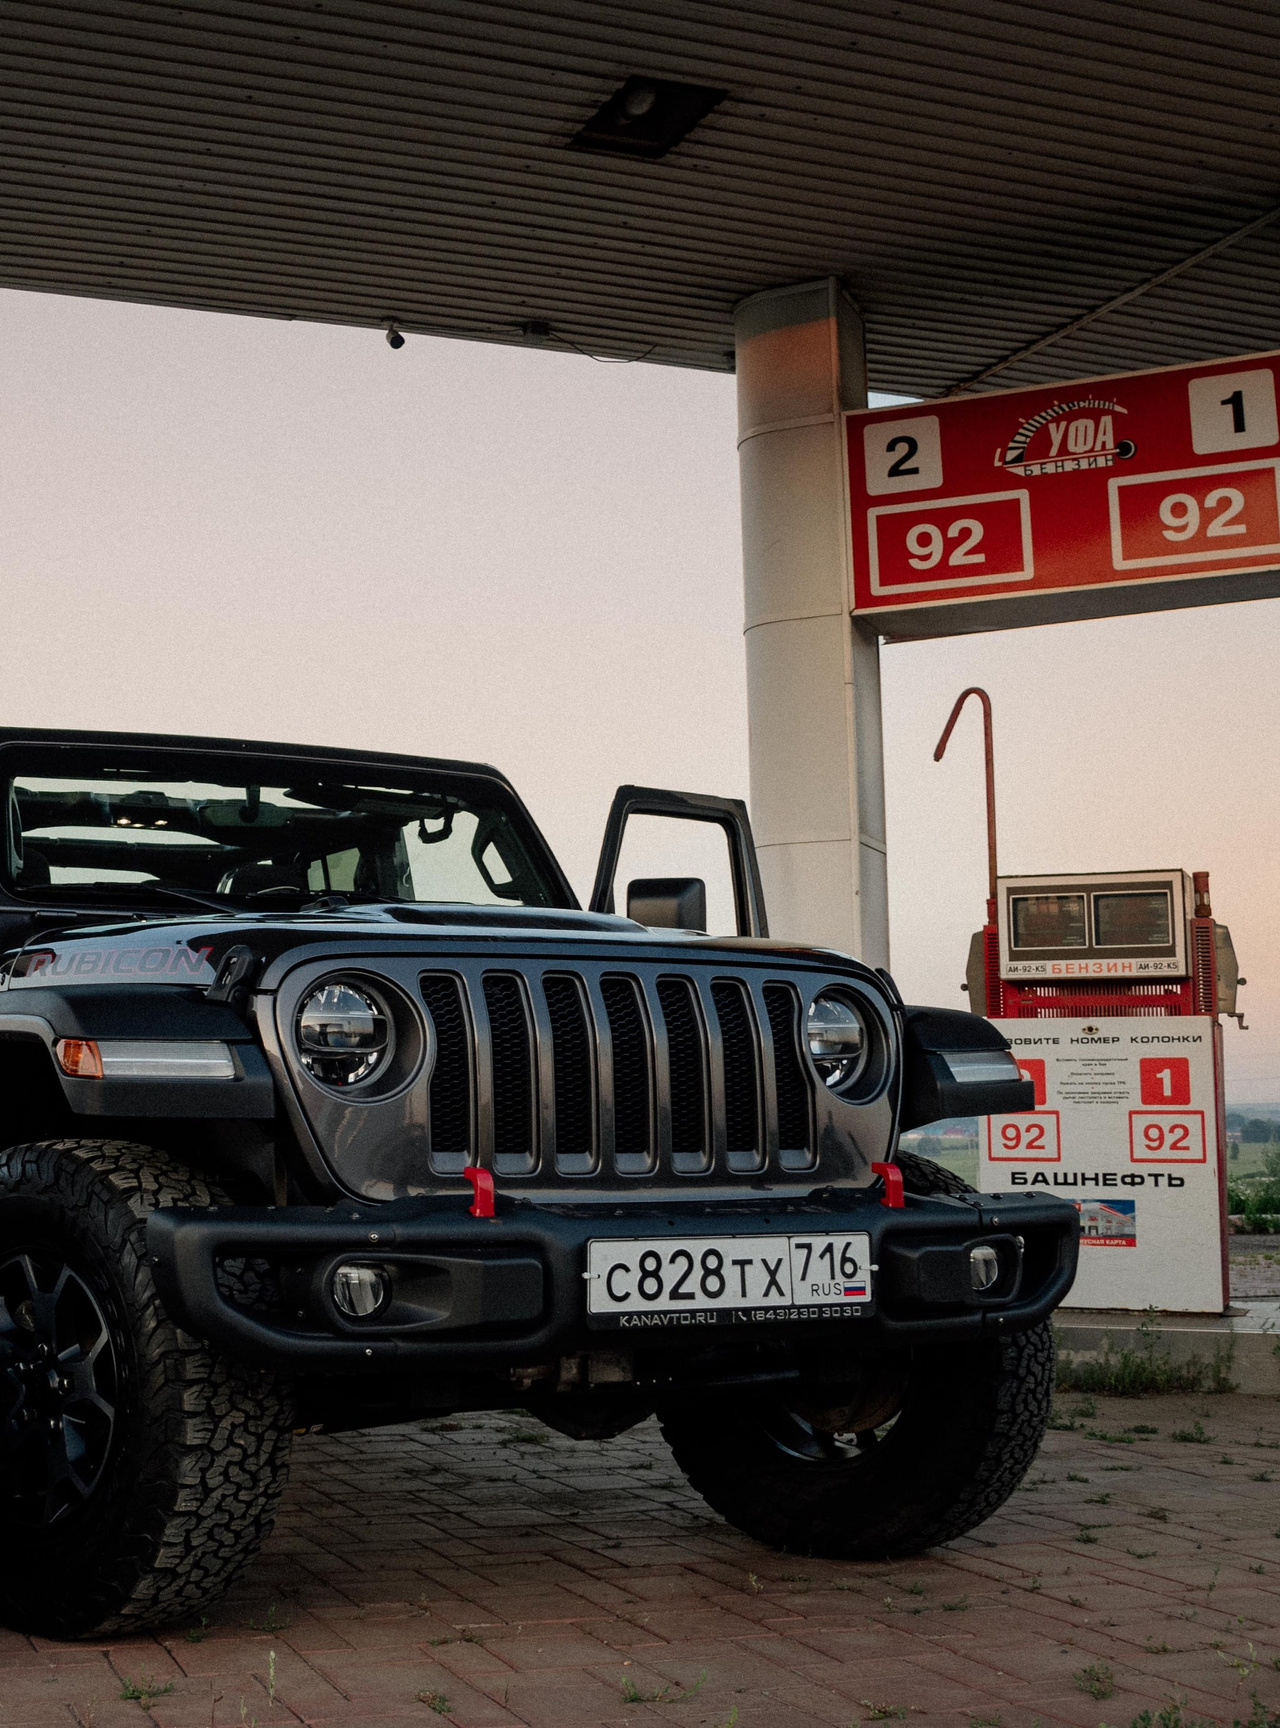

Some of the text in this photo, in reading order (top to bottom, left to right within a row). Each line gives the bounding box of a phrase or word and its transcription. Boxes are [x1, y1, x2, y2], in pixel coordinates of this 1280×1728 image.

[1220, 390, 1246, 434] 1
[1048, 415, 1114, 457] УФА
[885, 435, 919, 478] 2
[1023, 455, 1116, 476] БЕНЗИН
[1159, 487, 1247, 542] 92
[905, 518, 986, 570] 92
[25, 946, 215, 978] RUBICON
[1051, 962, 1132, 974] БЕНЗИН
[1070, 1036, 1120, 1044] НОМЕР
[1130, 1035, 1202, 1044] КОЛОНКИ
[1156, 1068, 1172, 1097] 1
[1000, 1123, 1046, 1150] 92
[1143, 1123, 1190, 1151] 92
[1010, 1171, 1185, 1188] БАШНЕФТЬ
[794, 1241, 858, 1282] 716
[811, 1282, 842, 1297] RUS
[620, 1311, 717, 1328] KANAVTO.RU
